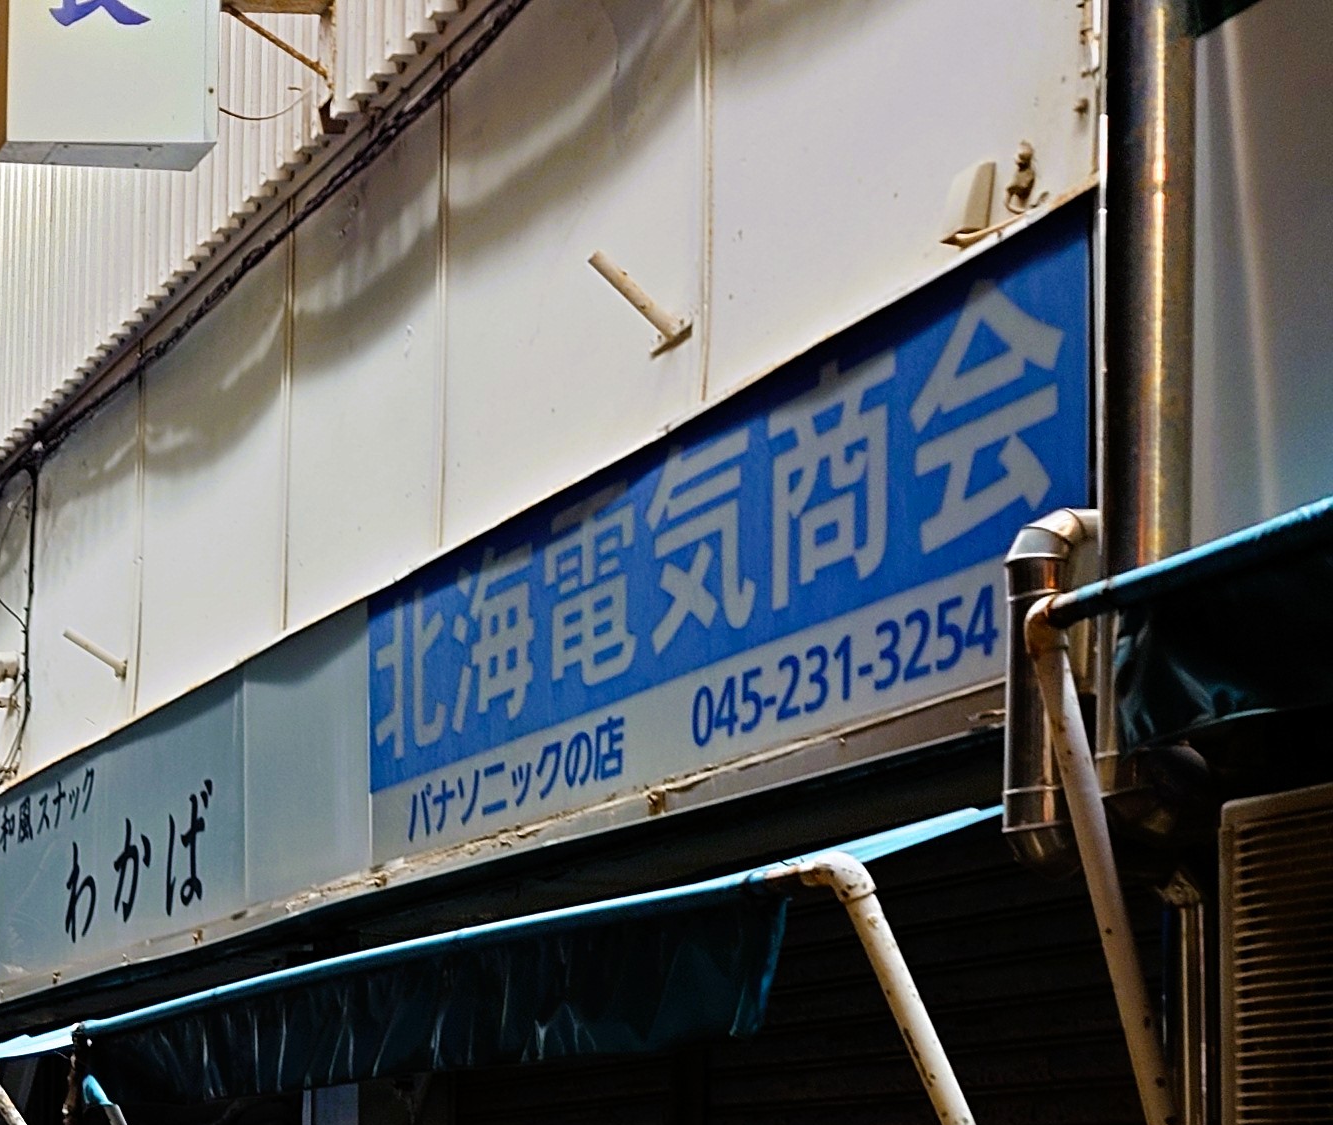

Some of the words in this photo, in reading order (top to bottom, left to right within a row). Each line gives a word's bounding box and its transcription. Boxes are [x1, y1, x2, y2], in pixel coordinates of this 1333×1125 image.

[376, 279, 1066, 763] 北海電気商会
[692, 584, 1000, 748] 045-231-3254
[0, 767, 94, 852] 和風スナック
[66, 779, 213, 943] わかば
[408, 716, 625, 842] パナソニックの店
